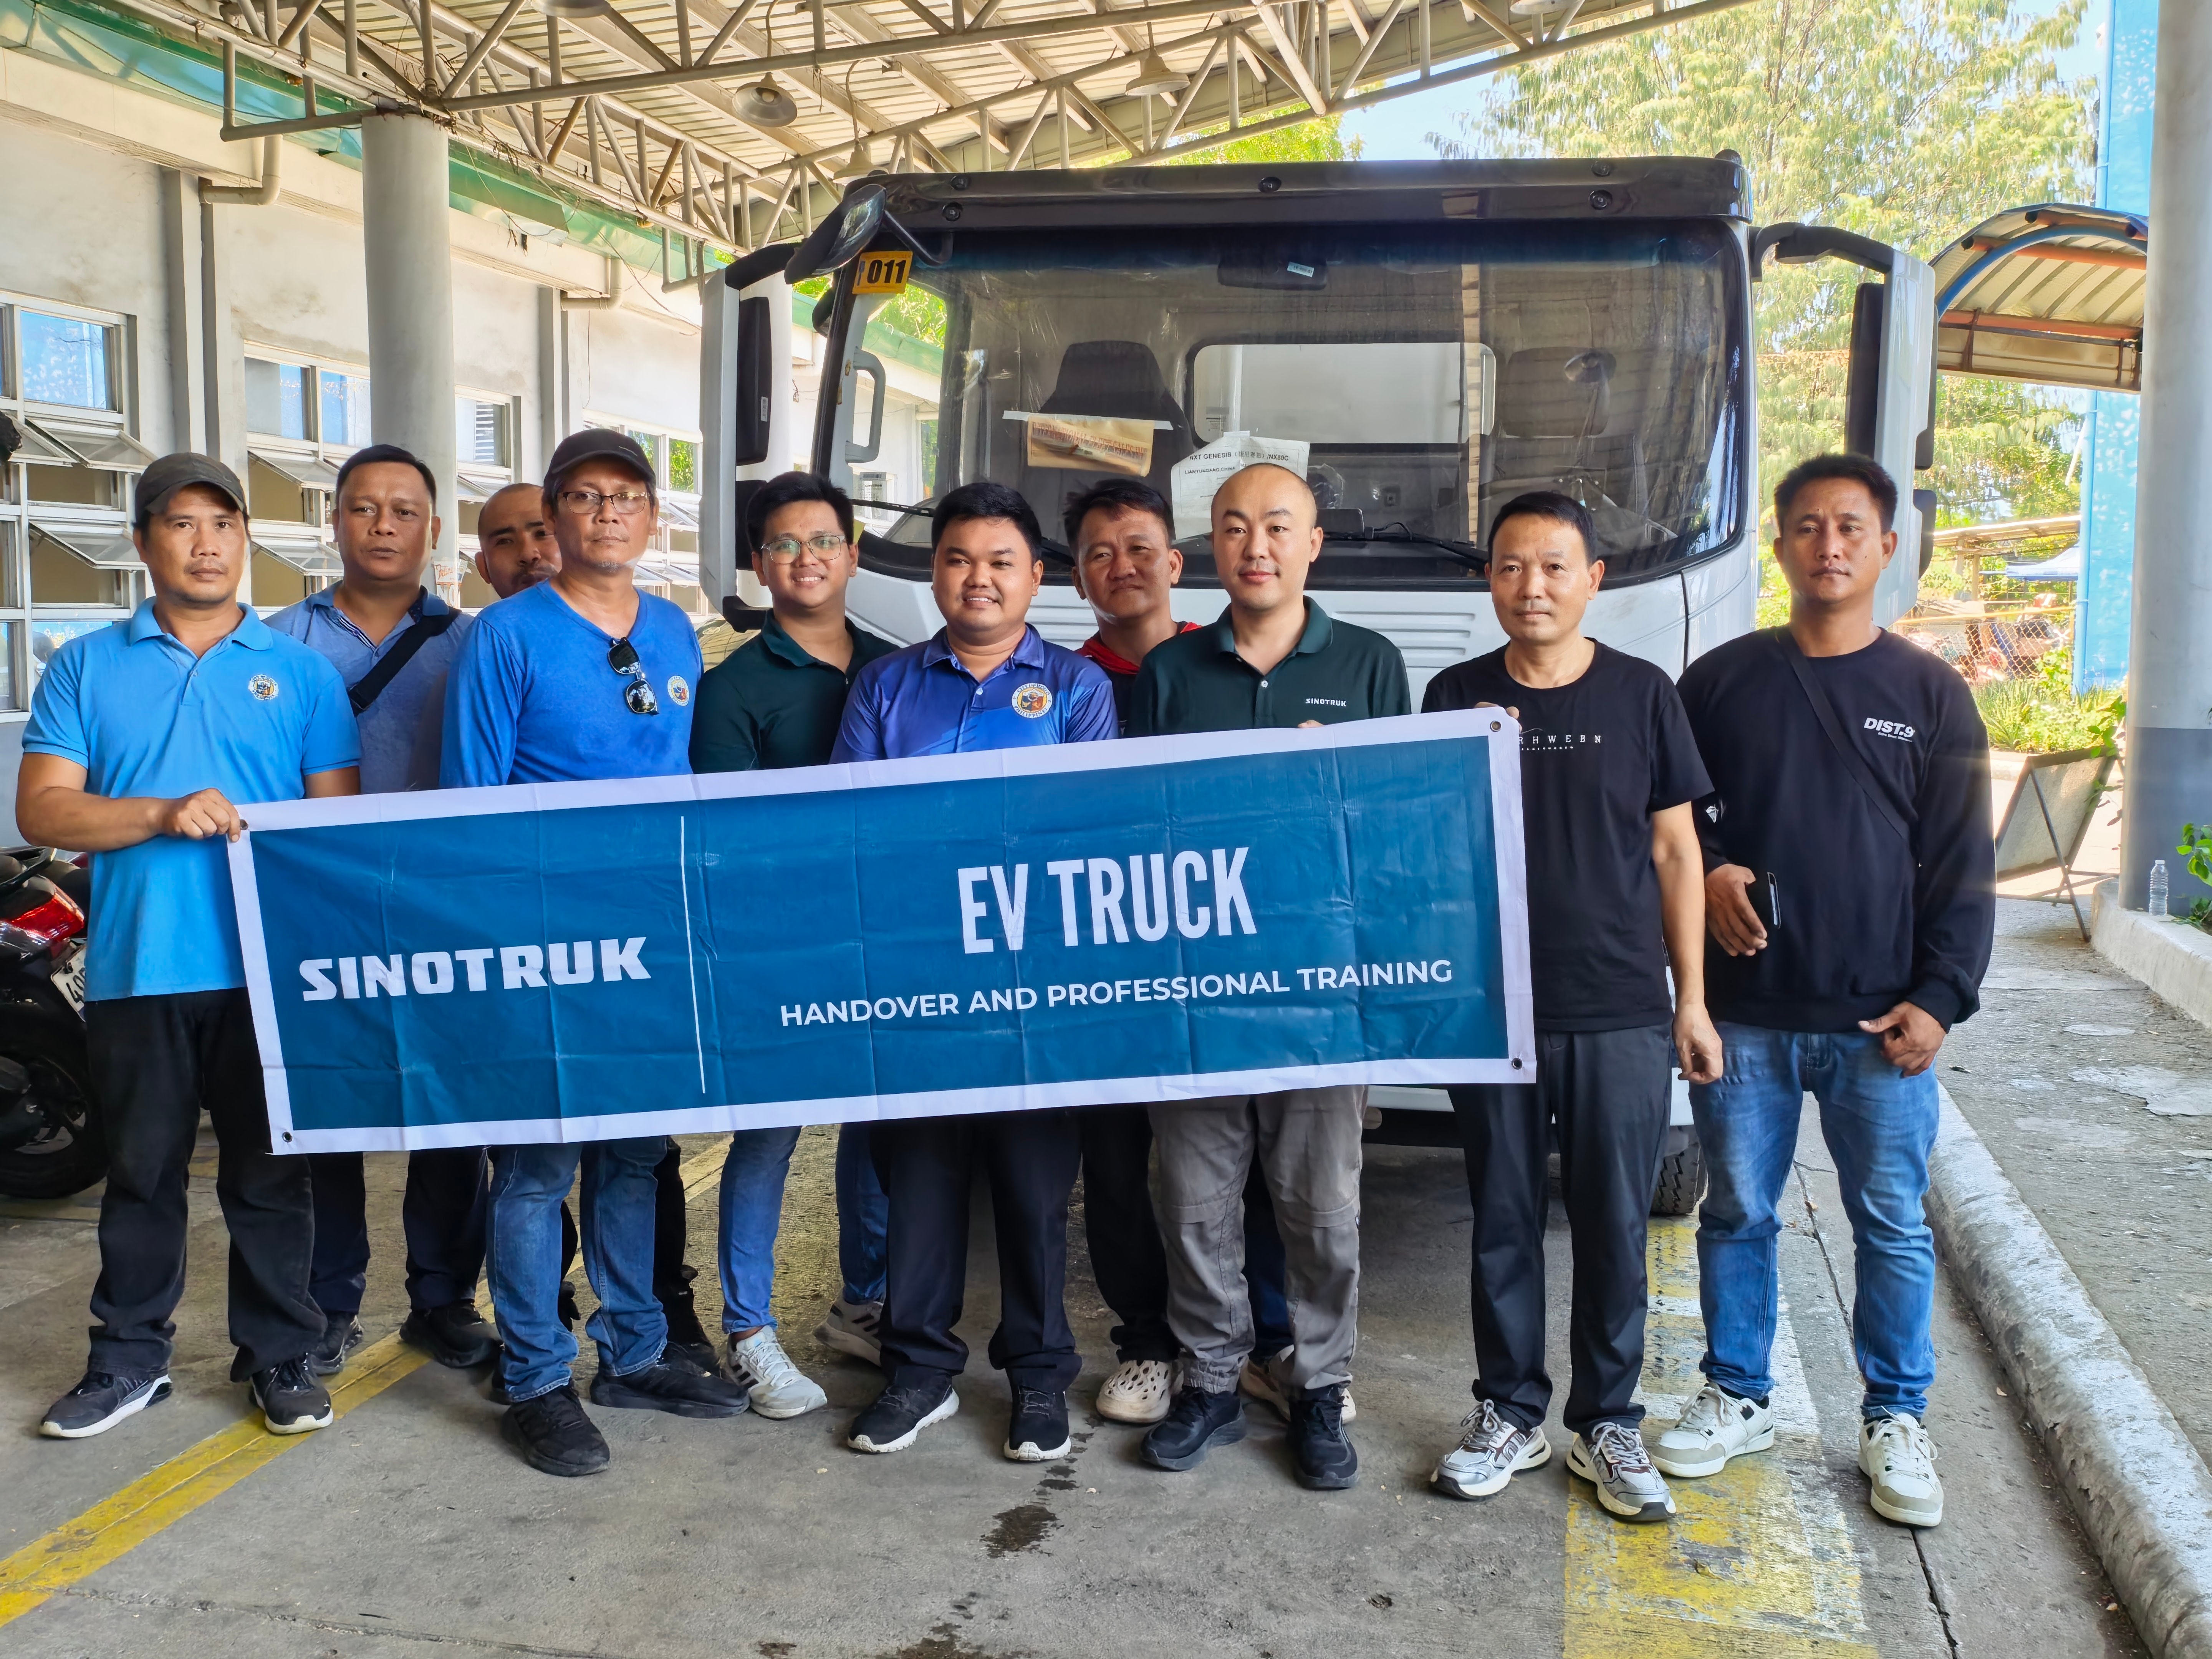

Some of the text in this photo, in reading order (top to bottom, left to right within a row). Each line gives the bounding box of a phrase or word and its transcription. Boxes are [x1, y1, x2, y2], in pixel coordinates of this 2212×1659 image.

[868, 260, 906, 283] 011
[1305, 698, 1346, 707] SINOTRUK
[1864, 717, 1915, 738] DIST.9
[958, 847, 1257, 954] EV TRUCK
[300, 937, 651, 1001] SINOTRUK
[781, 960, 1452, 1027] HANDOVER AND PROFESSIONAL TRAINING
